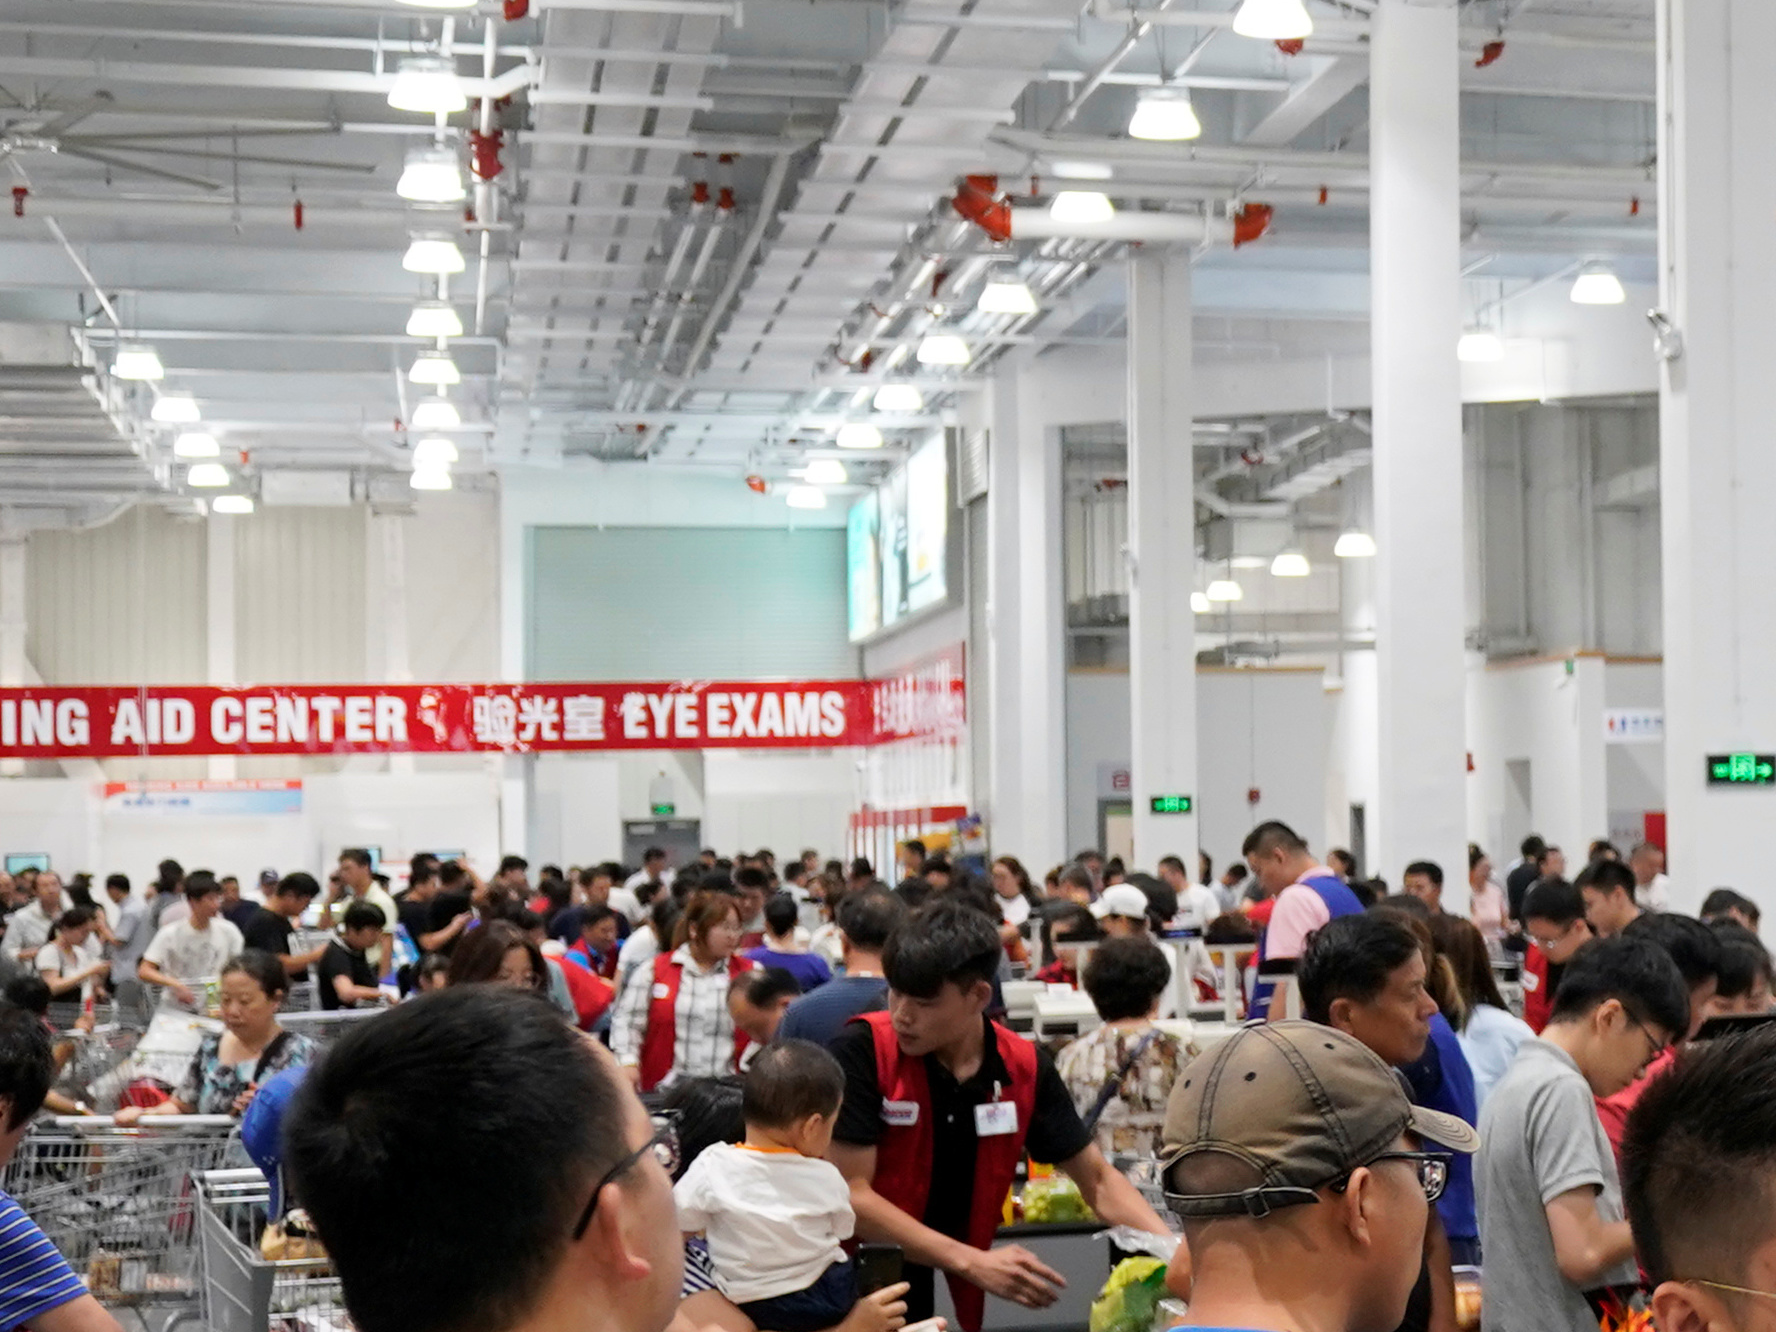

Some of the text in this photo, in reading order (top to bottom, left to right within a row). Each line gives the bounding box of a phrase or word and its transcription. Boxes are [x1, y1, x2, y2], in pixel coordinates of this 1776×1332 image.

[109, 697, 196, 746] AID
[210, 696, 408, 745] CENTER
[622, 692, 698, 739] EYE
[706, 690, 845, 738] EXAMS
